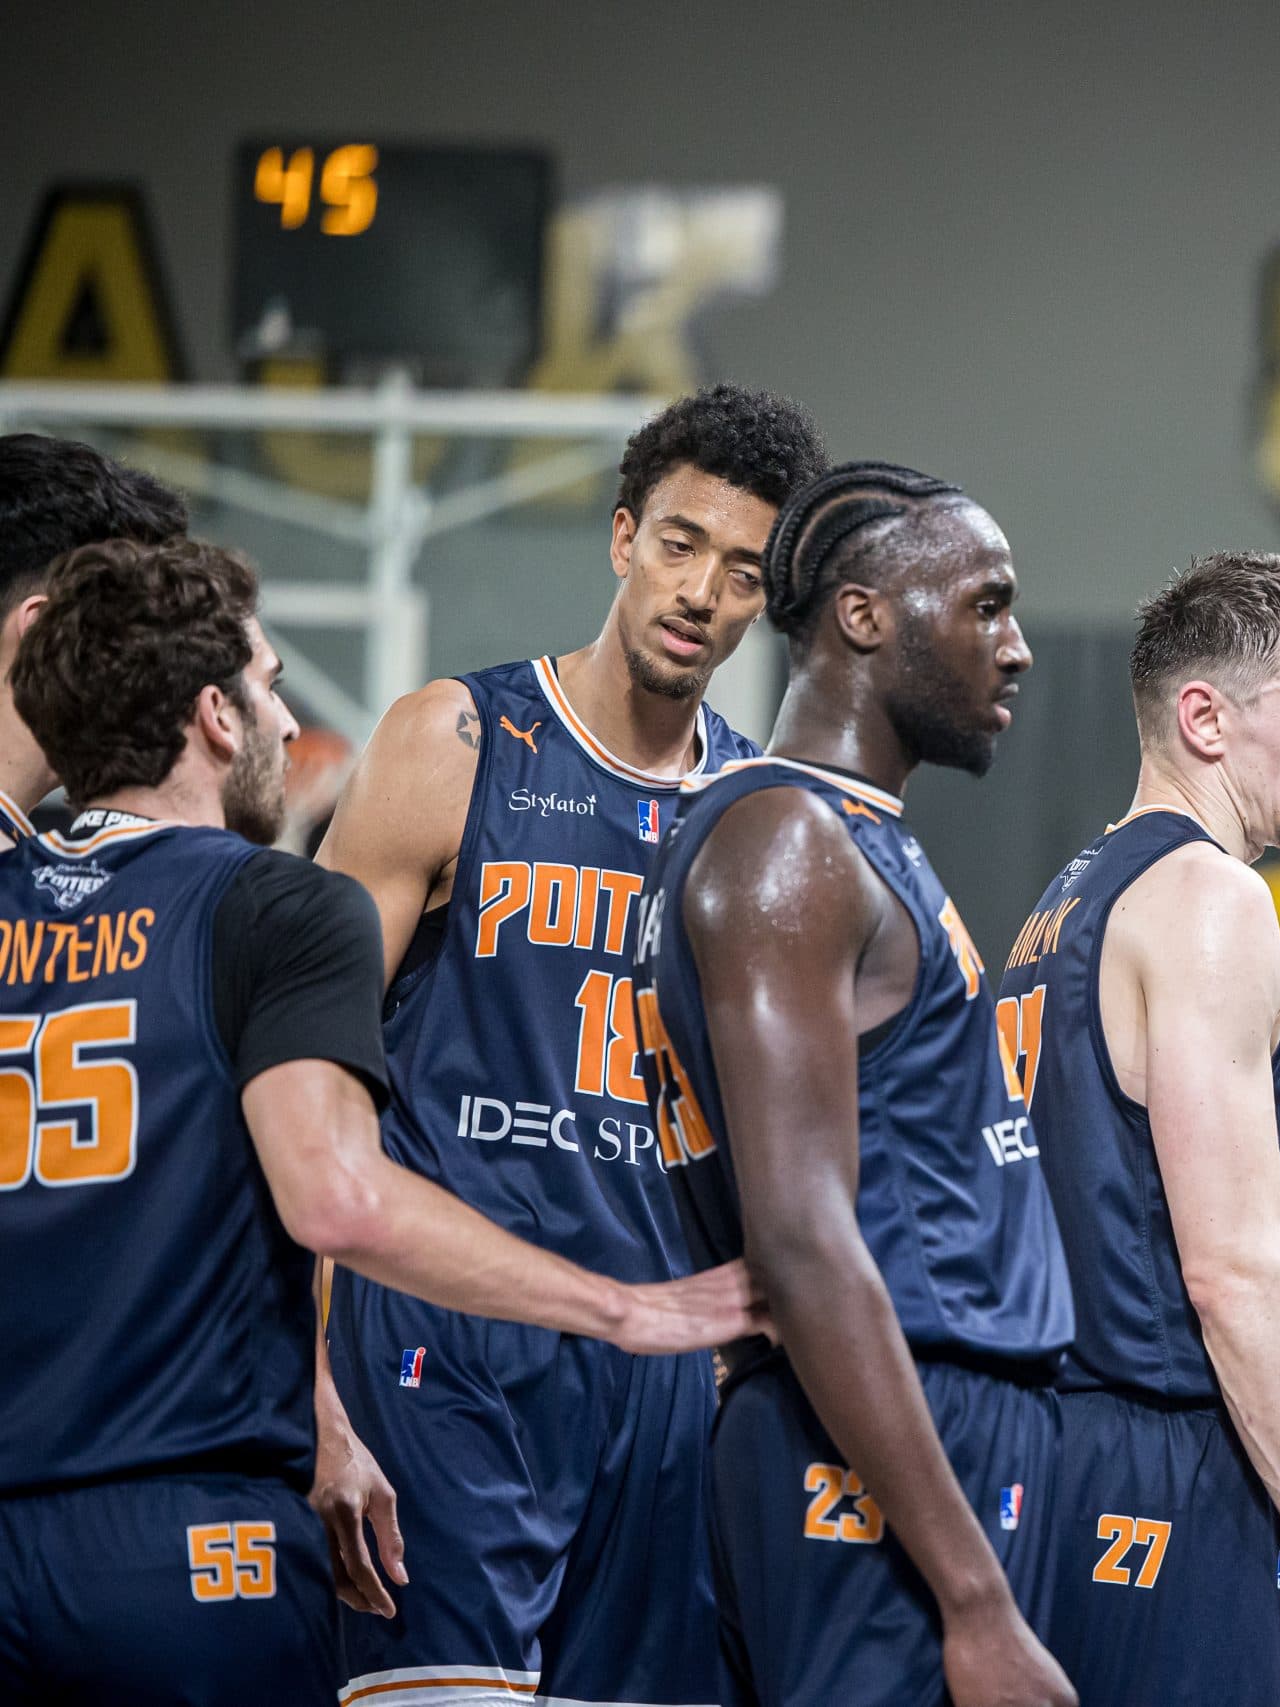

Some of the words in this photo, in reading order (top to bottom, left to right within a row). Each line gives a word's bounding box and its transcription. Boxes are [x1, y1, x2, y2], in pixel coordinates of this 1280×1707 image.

[255, 144, 378, 235] 45
[0, 180, 782, 505] AK
[457, 1095, 579, 1152] IDEC
[804, 1462, 883, 1544] 23
[187, 1521, 276, 1602] 55
[1093, 1514, 1172, 1588] 27
